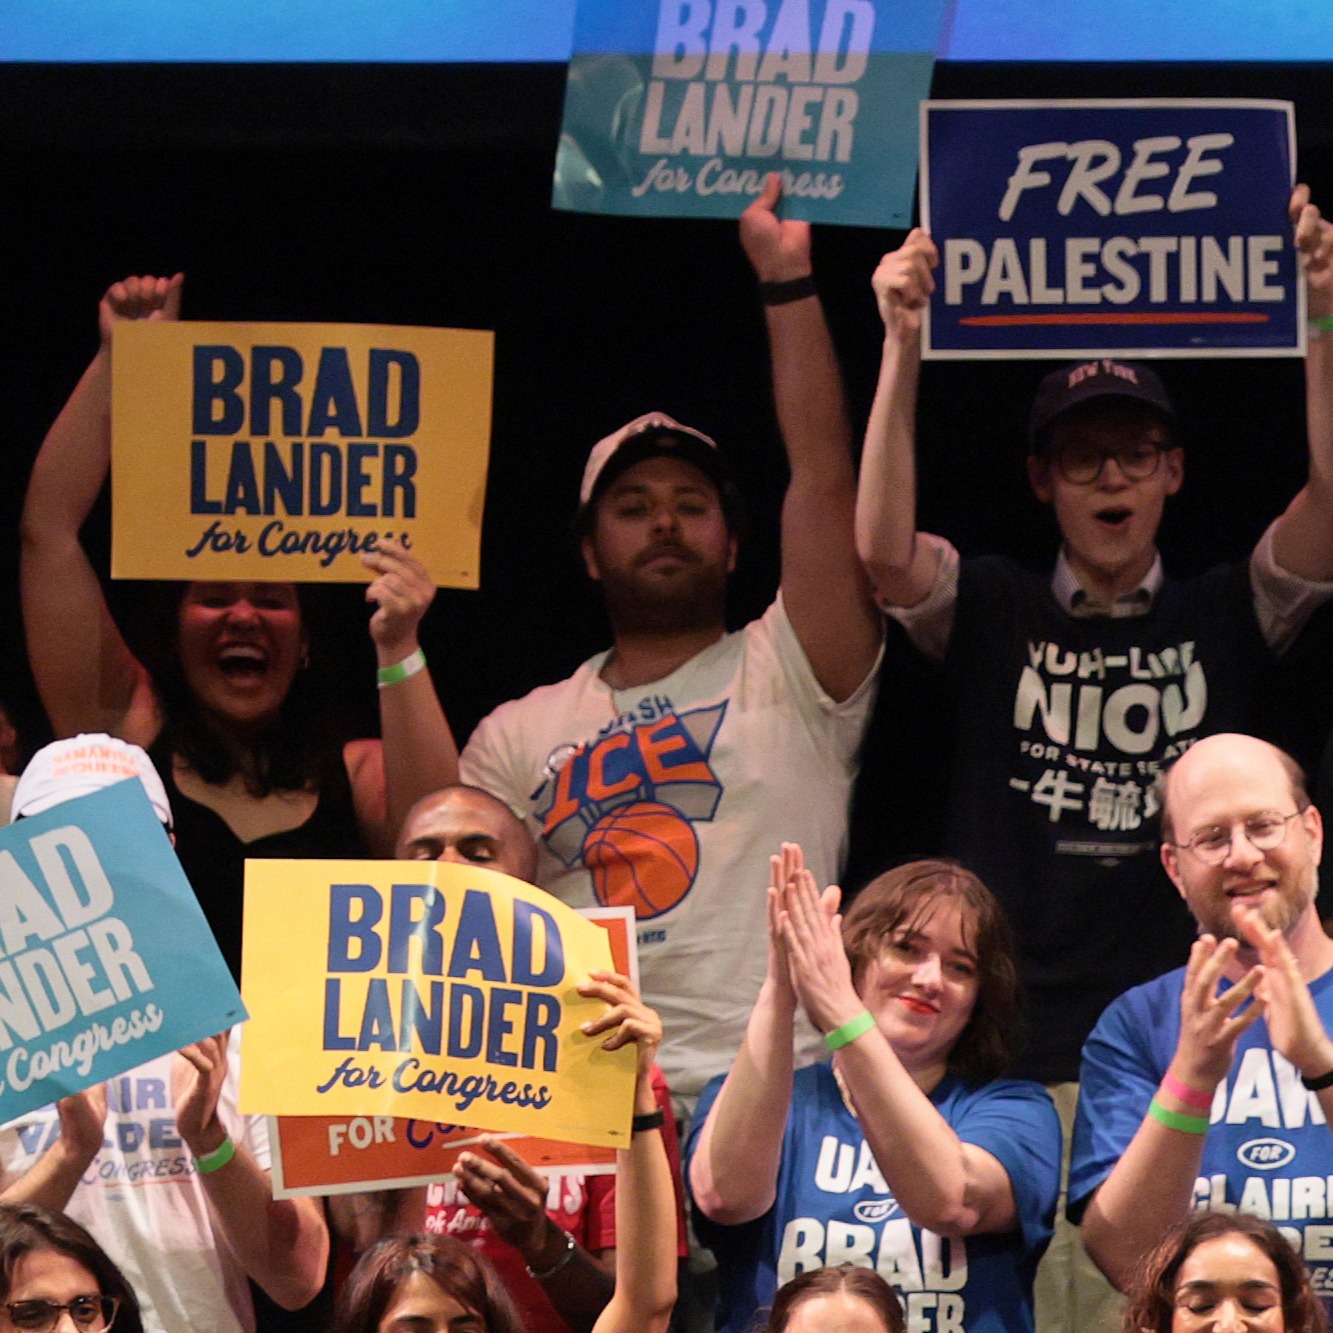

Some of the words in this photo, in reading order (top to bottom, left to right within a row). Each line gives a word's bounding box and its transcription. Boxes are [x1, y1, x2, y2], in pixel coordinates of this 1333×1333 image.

[652, 0, 876, 84] BRAD
[639, 81, 860, 163] LANDER
[632, 157, 690, 198] for
[999, 133, 1234, 222] FREE
[944, 236, 1285, 305] PALESTINE
[191, 344, 421, 438] BRAD
[189, 441, 418, 519] LANDER
[185, 525, 252, 558] for
[1013, 660, 1208, 755] NIOU
[541, 714, 720, 838] ICE
[0, 823, 115, 960] AD
[326, 883, 565, 989] BRAD
[0, 916, 156, 1052] NDER
[322, 977, 563, 1073] LANDER
[6, 1003, 164, 1093] Congress
[316, 1057, 387, 1095] for
[392, 1057, 553, 1112] Congress
[328, 1115, 396, 1157] FOR
[814, 1135, 891, 1194] UA
[1249, 1144, 1285, 1162] FOR
[777, 1217, 969, 1294] BRAD
